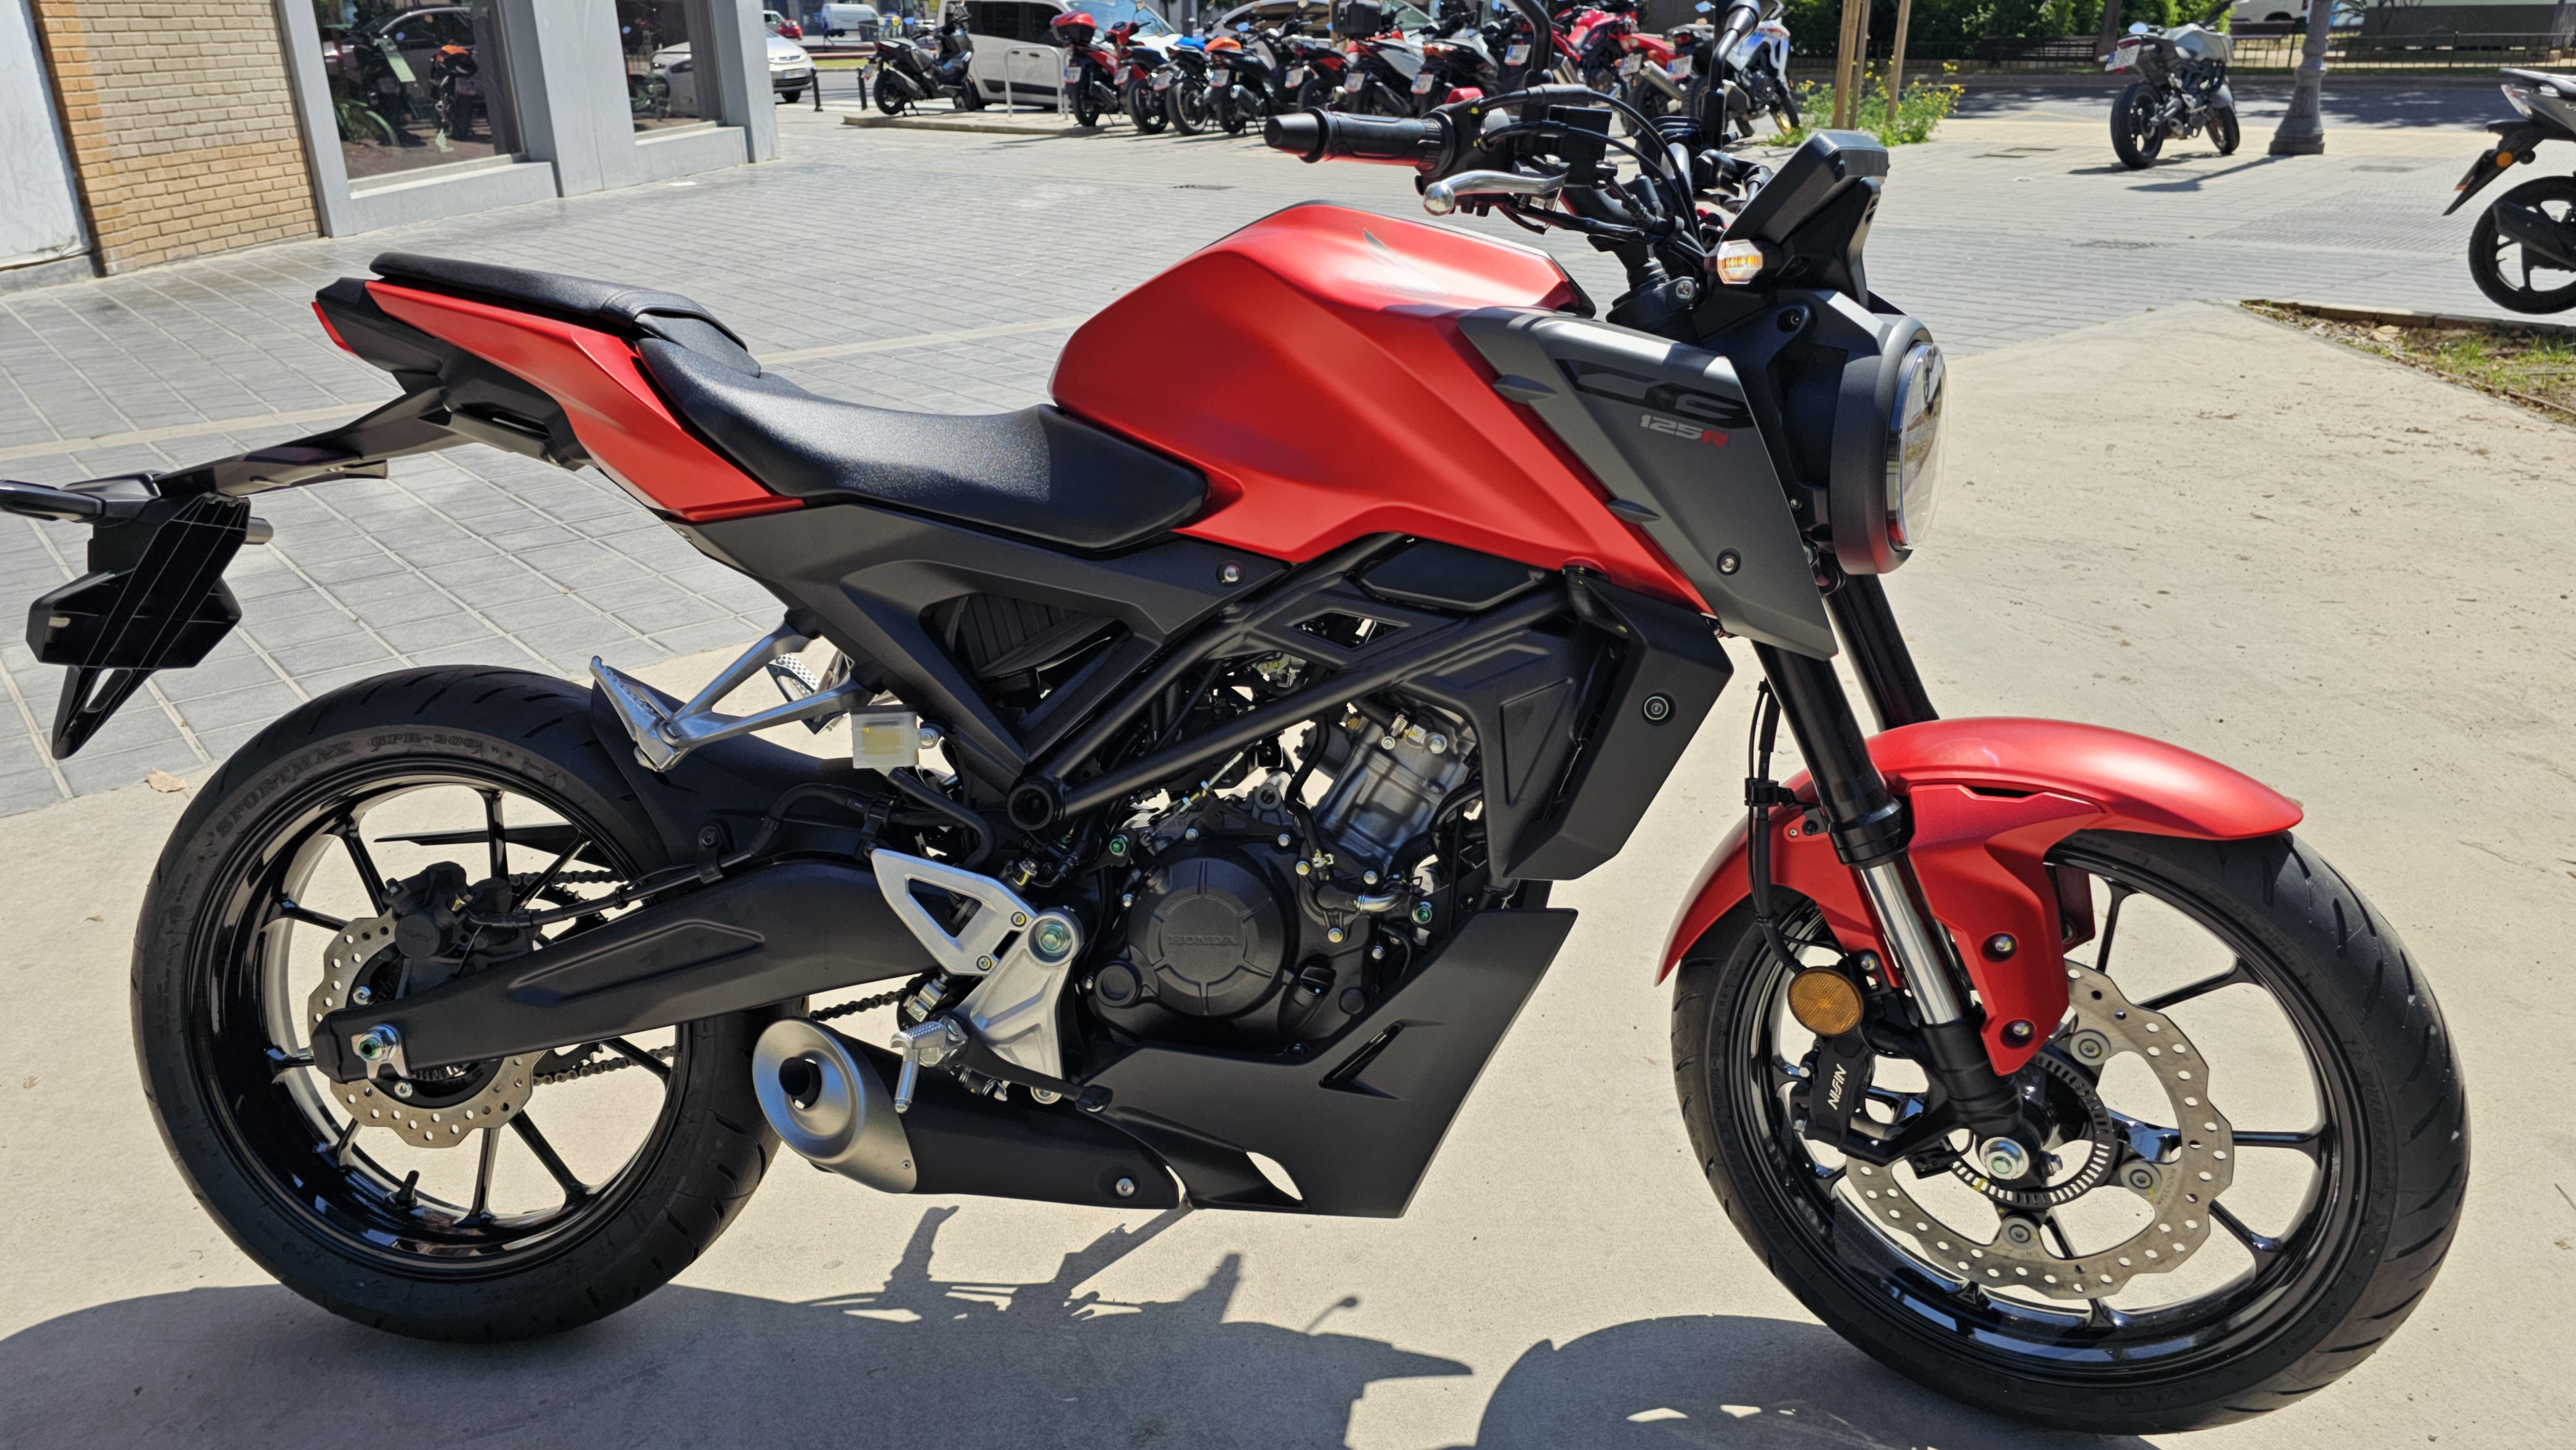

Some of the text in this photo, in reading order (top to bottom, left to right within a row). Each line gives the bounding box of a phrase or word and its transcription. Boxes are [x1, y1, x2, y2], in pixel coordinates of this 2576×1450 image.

[1640, 414, 1728, 447] 125R
[370, 732, 480, 748] GPR-300
[216, 740, 354, 839] SPORTMAX
[1168, 935, 1239, 945] HONDA
[1828, 1063, 1846, 1111] NISSIN
